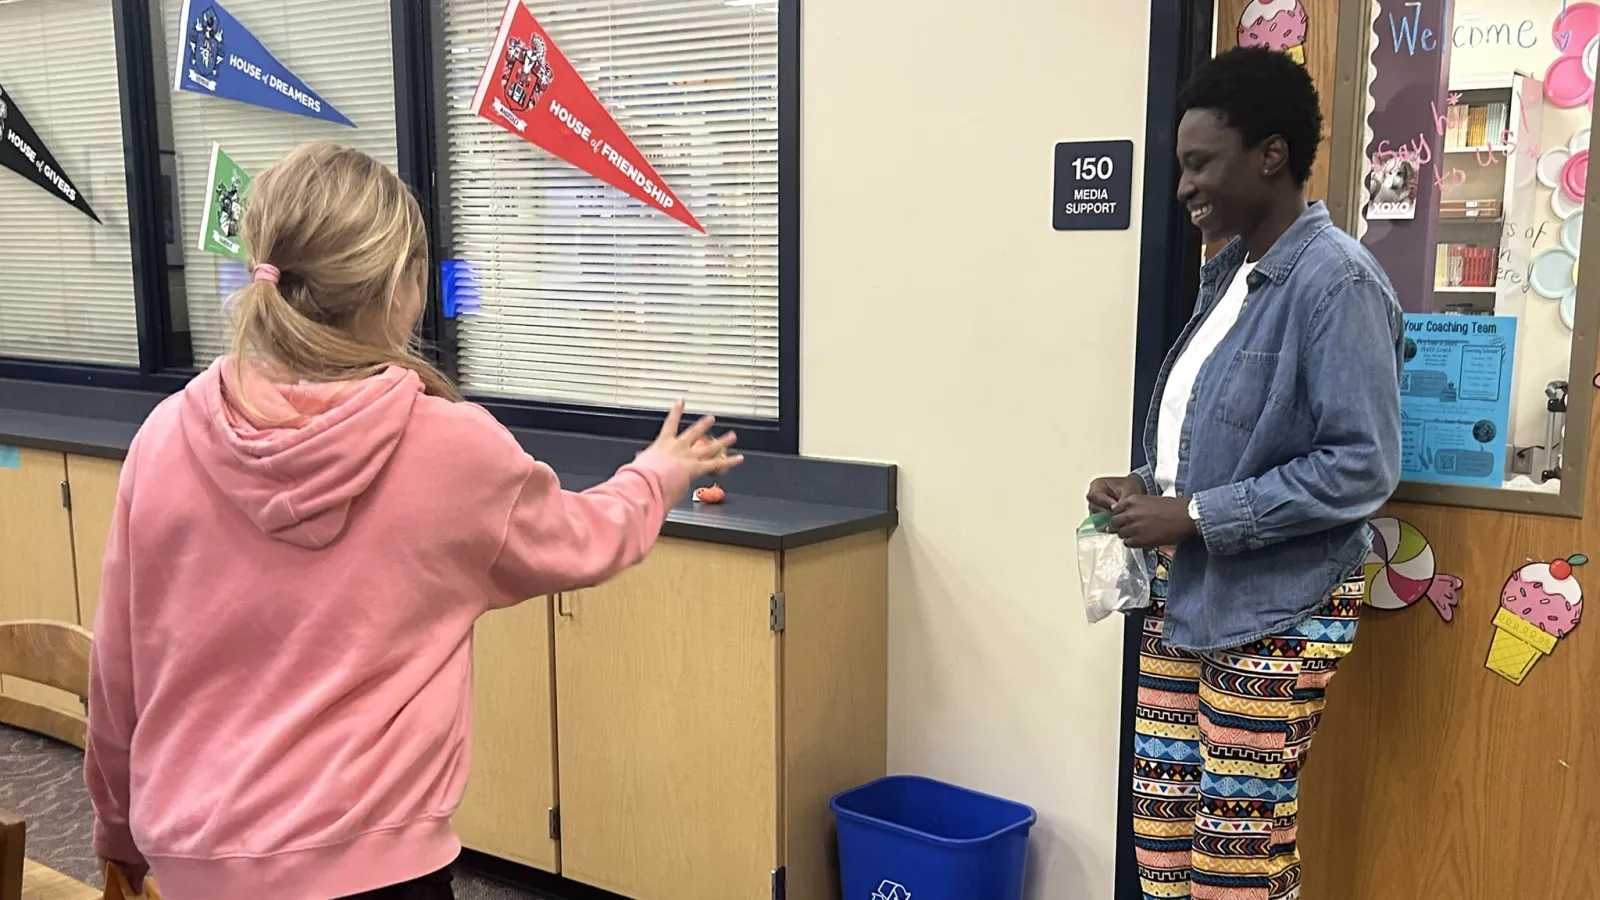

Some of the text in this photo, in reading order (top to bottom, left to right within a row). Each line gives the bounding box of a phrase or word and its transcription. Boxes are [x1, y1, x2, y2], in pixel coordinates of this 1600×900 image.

[229, 54, 321, 113] HOUSE of DREAMERS
[8, 128, 76, 201] HOUSE of GIVERS
[549, 99, 674, 208] HOUSE of FRIENDSHIP
[1071, 156, 1114, 180] 150
[1074, 188, 1108, 200] MEDIA
[1065, 202, 1117, 214] SUPPORT
[1373, 202, 1409, 213] XOXO
[1524, 220, 1549, 248] of
[1404, 320, 1497, 336] Your Coaching Team
